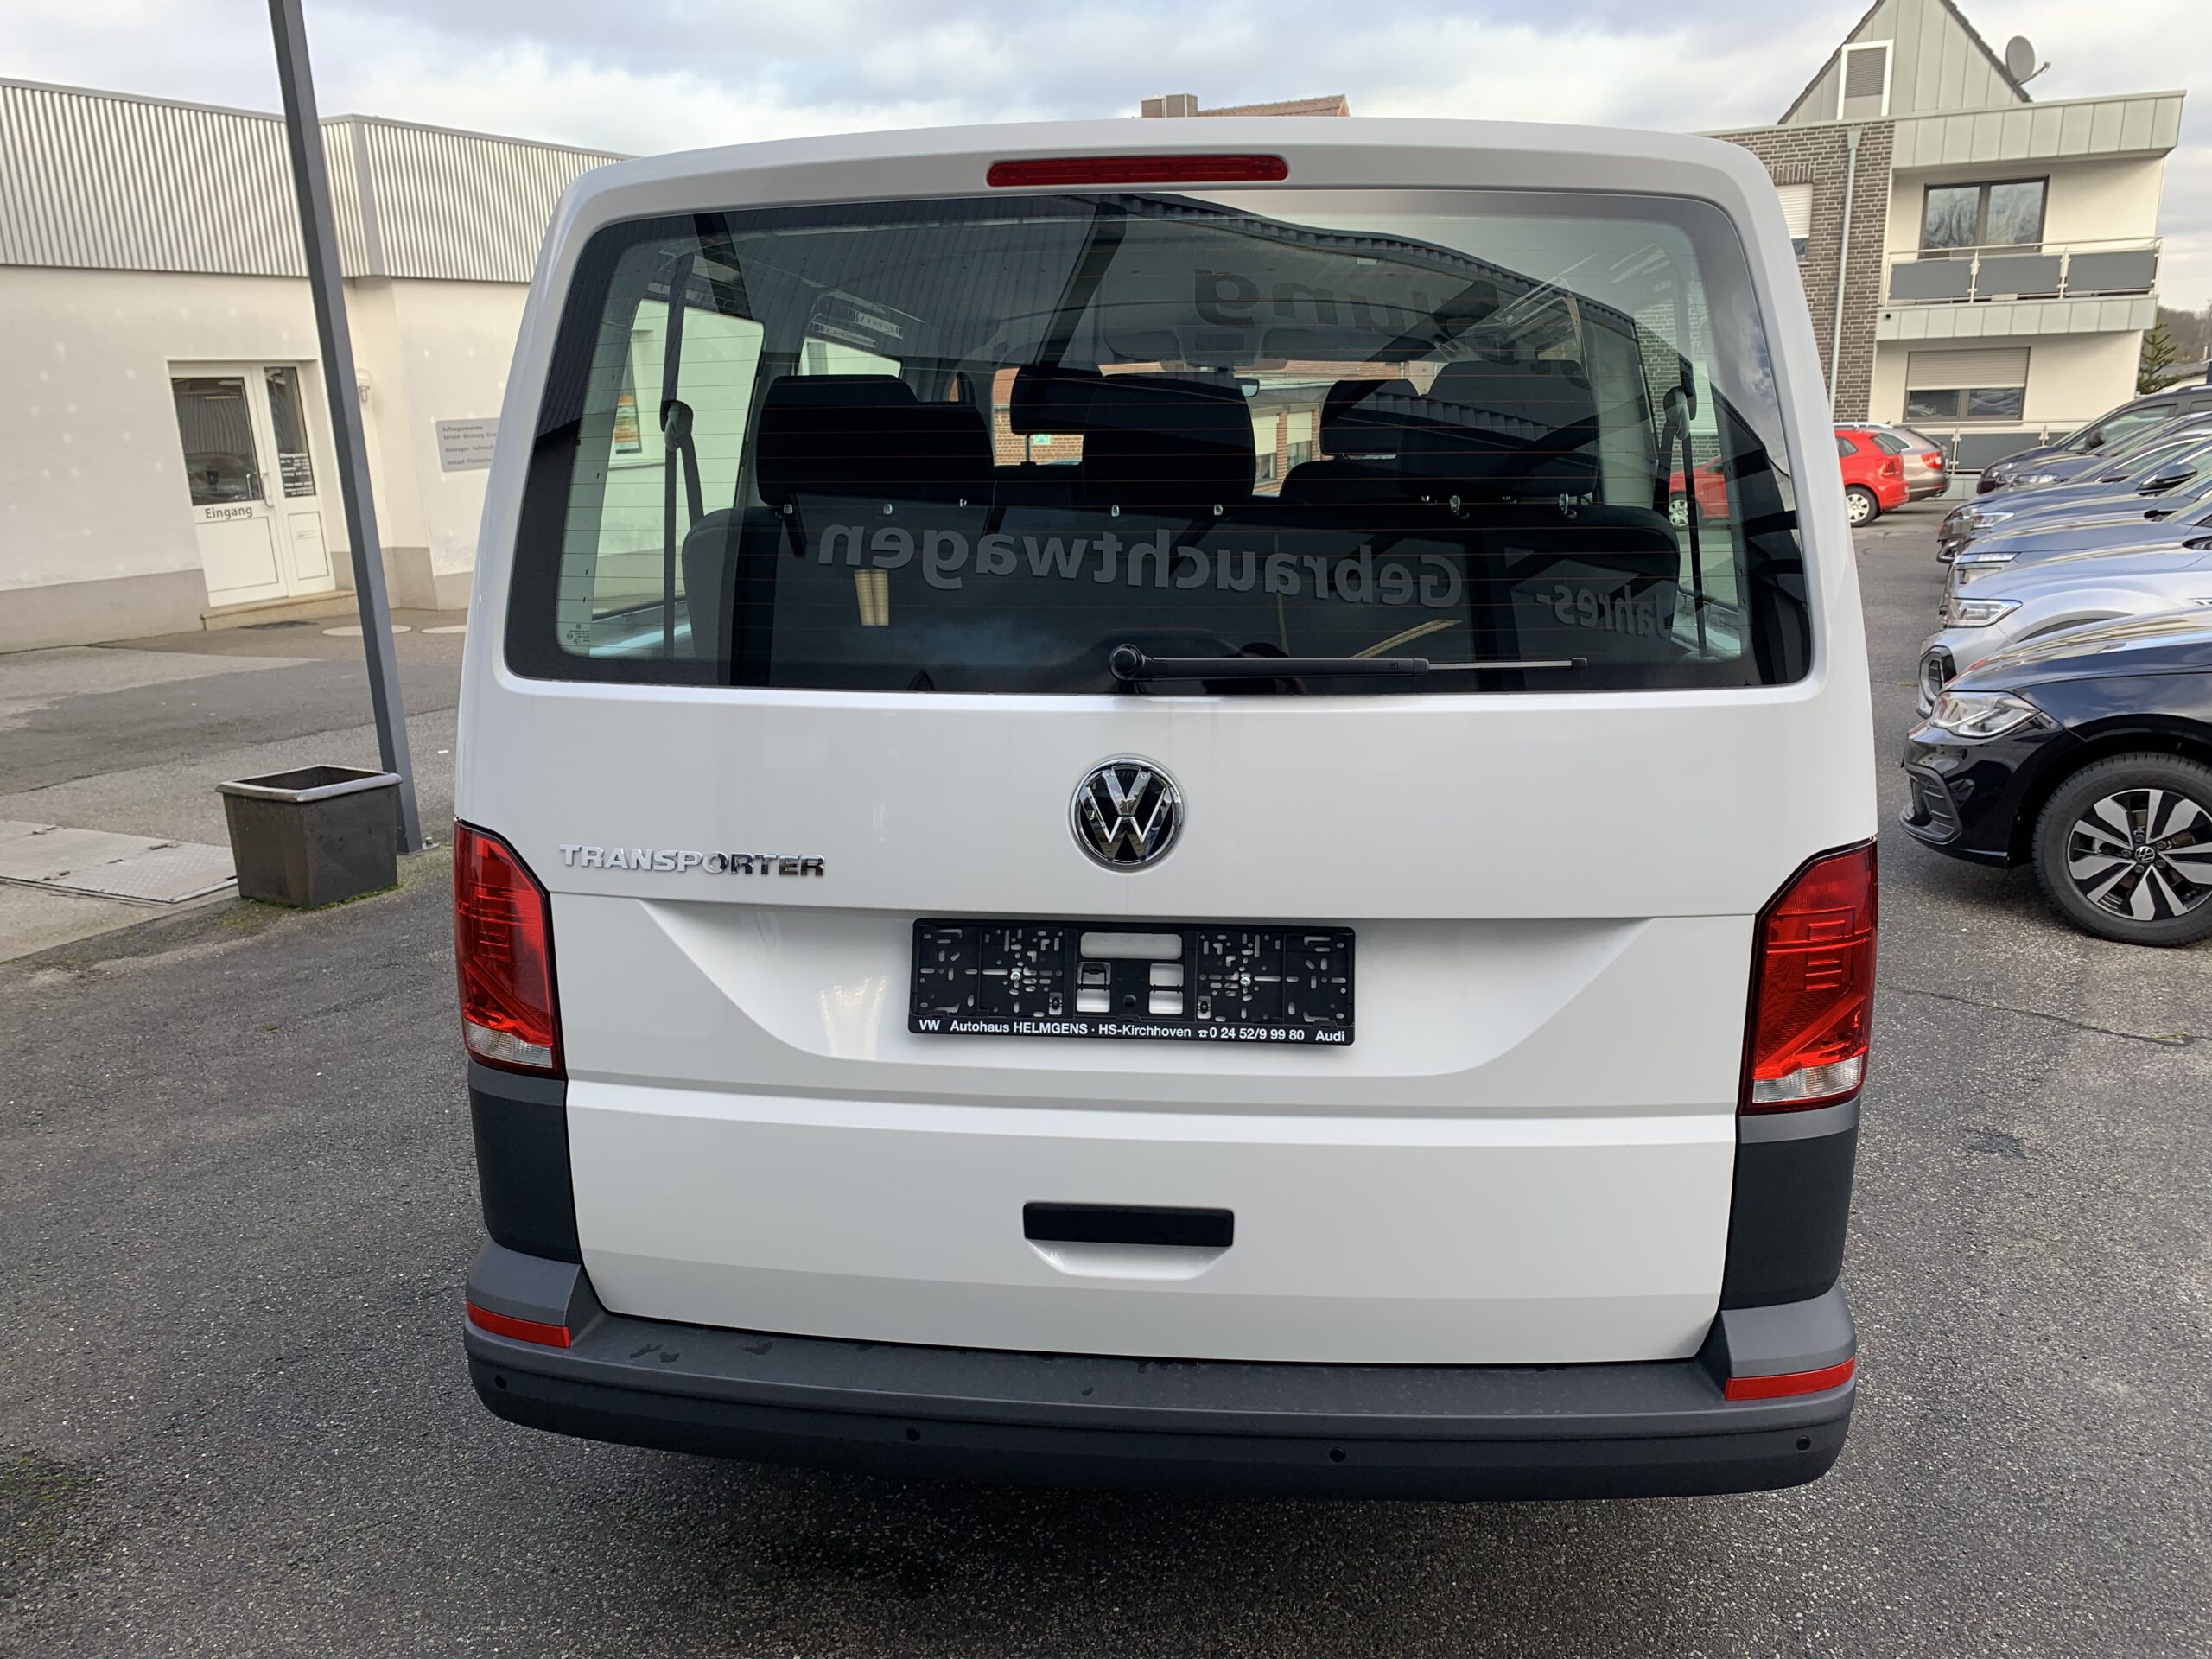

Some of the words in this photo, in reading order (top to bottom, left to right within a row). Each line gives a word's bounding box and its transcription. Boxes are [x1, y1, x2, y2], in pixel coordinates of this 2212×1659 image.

[205, 506, 253, 520] Eingang
[559, 843, 826, 877] TRANSPORTER
[918, 1019, 941, 1032] VW
[950, 1020, 1010, 1033] Autohaus
[1013, 1021, 1089, 1035] HELMGENS
[1098, 1023, 1192, 1038] HS-Kirchhoven
[1220, 1027, 1236, 1039] 24
[1238, 1027, 1268, 1040] 52/9
[1269, 1028, 1287, 1041] 99
[1288, 1029, 1305, 1041] 80
[1314, 1029, 1345, 1042] Audi
